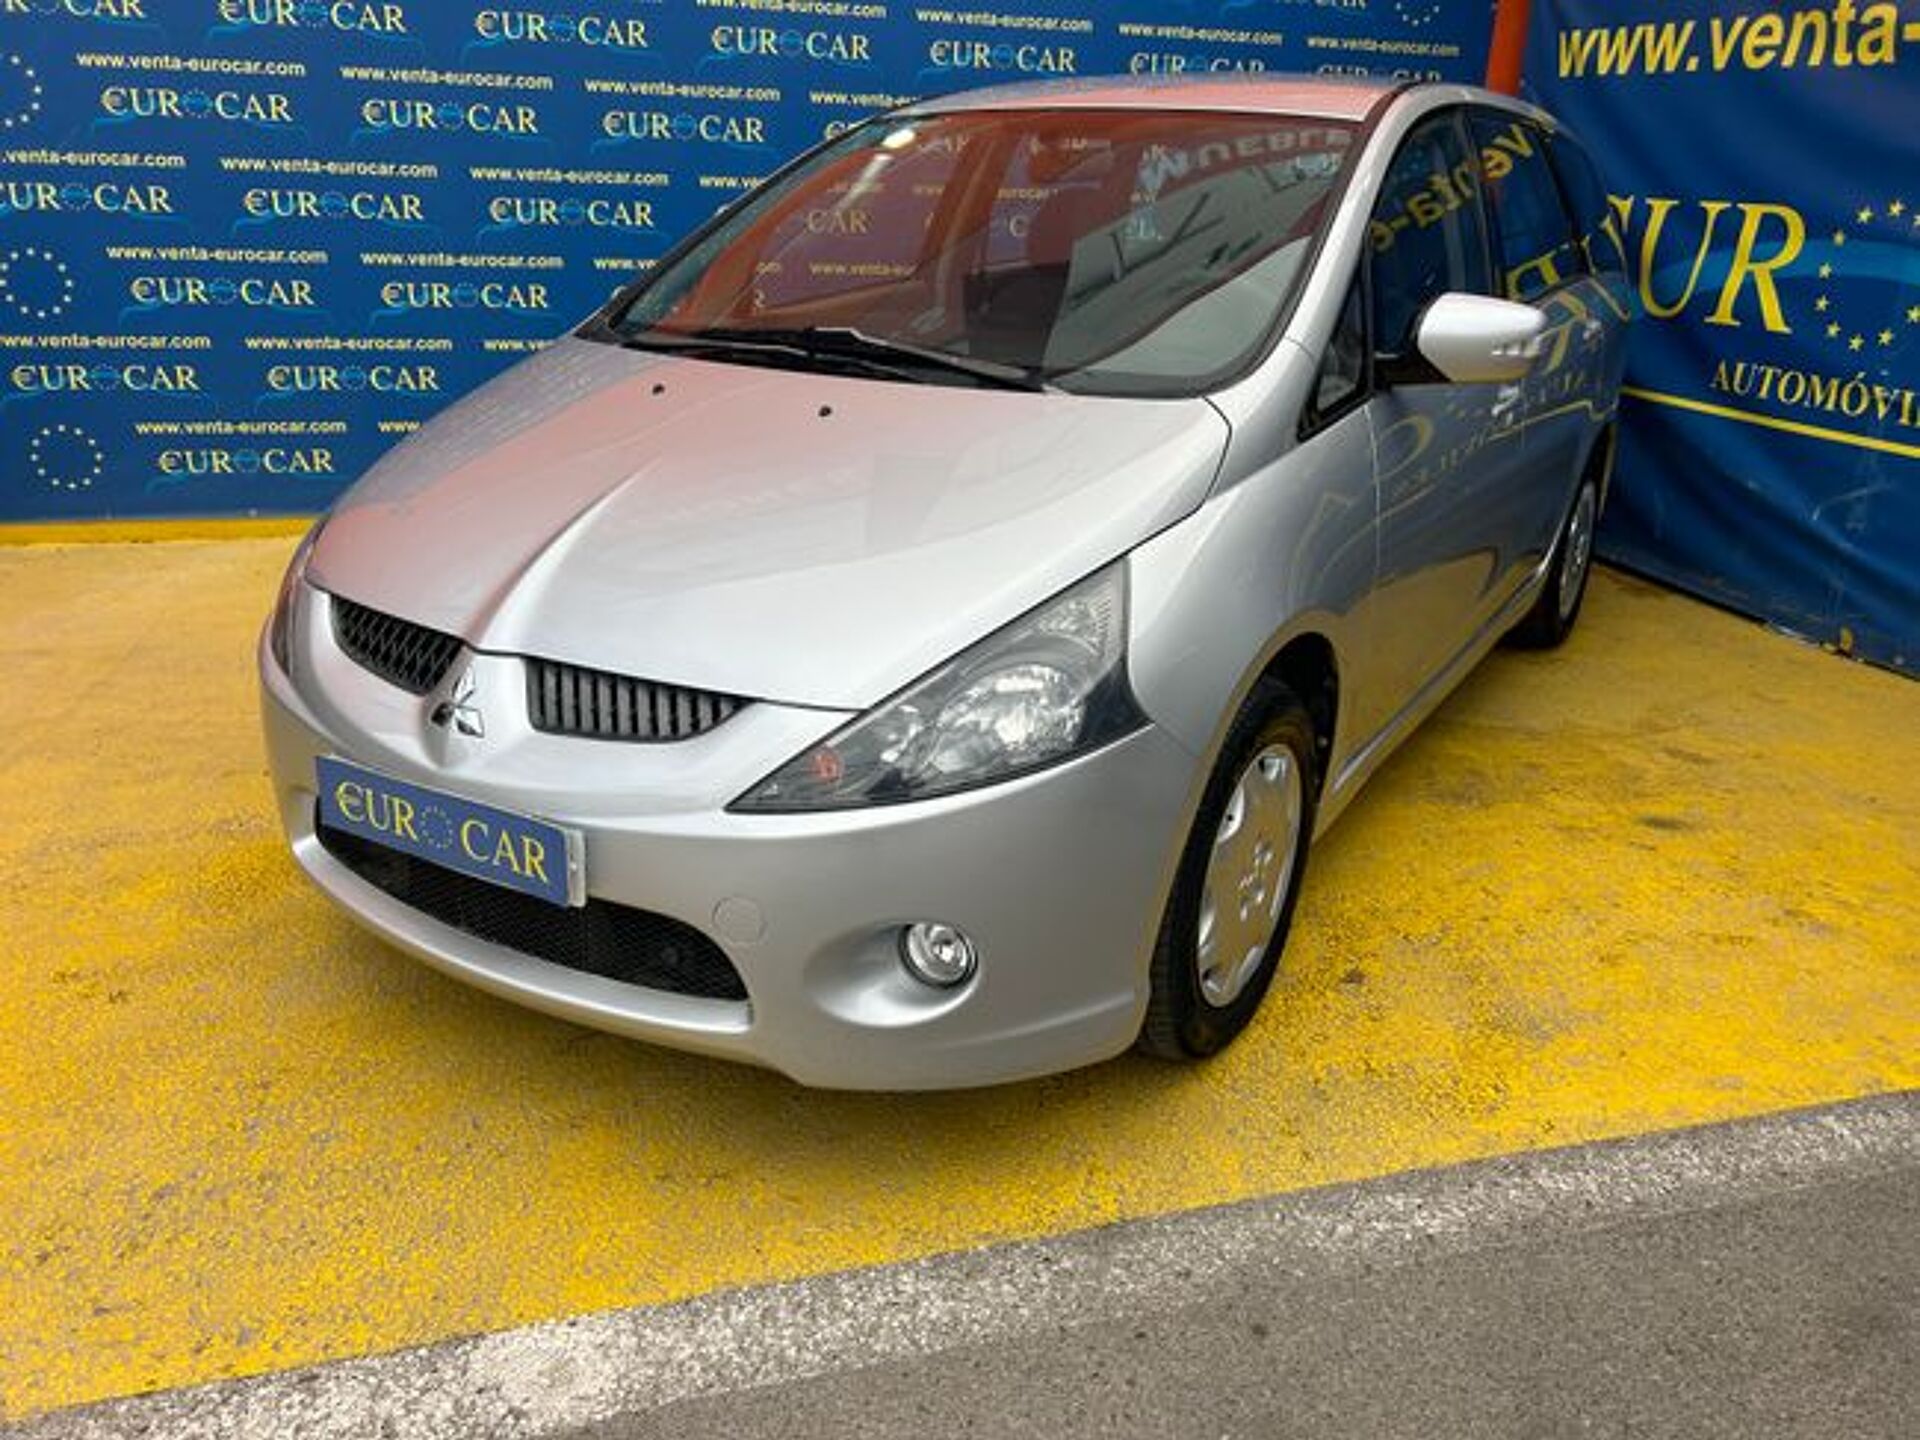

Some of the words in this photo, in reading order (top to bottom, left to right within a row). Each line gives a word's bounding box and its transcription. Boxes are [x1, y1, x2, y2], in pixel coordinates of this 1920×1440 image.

[915, 9, 1093, 32] www.venta-eurocar.com
[1118, 23, 1283, 45] www.venta-eurocar.com
[1306, 36, 1460, 57] www.venta-eurocar.com
[76, 53, 306, 76] www.venta-eurocar.com
[339, 66, 553, 90] www.venta-eurocar.com
[584, 79, 781, 101] www.venta-eurocar.com
[220, 157, 438, 178] www.venta-eurocar.com
[469, 167, 669, 186] www.venta-eurocar.com
[105, 246, 328, 264] www.venta-eurocar.com
[359, 252, 564, 269] www.venta-eurocar.com
[244, 336, 453, 351] www.venta-eurocar.com
[1709, 359, 1920, 429] AUTOMÓVI
[135, 421, 347, 434] www.venta-eurocar.com
